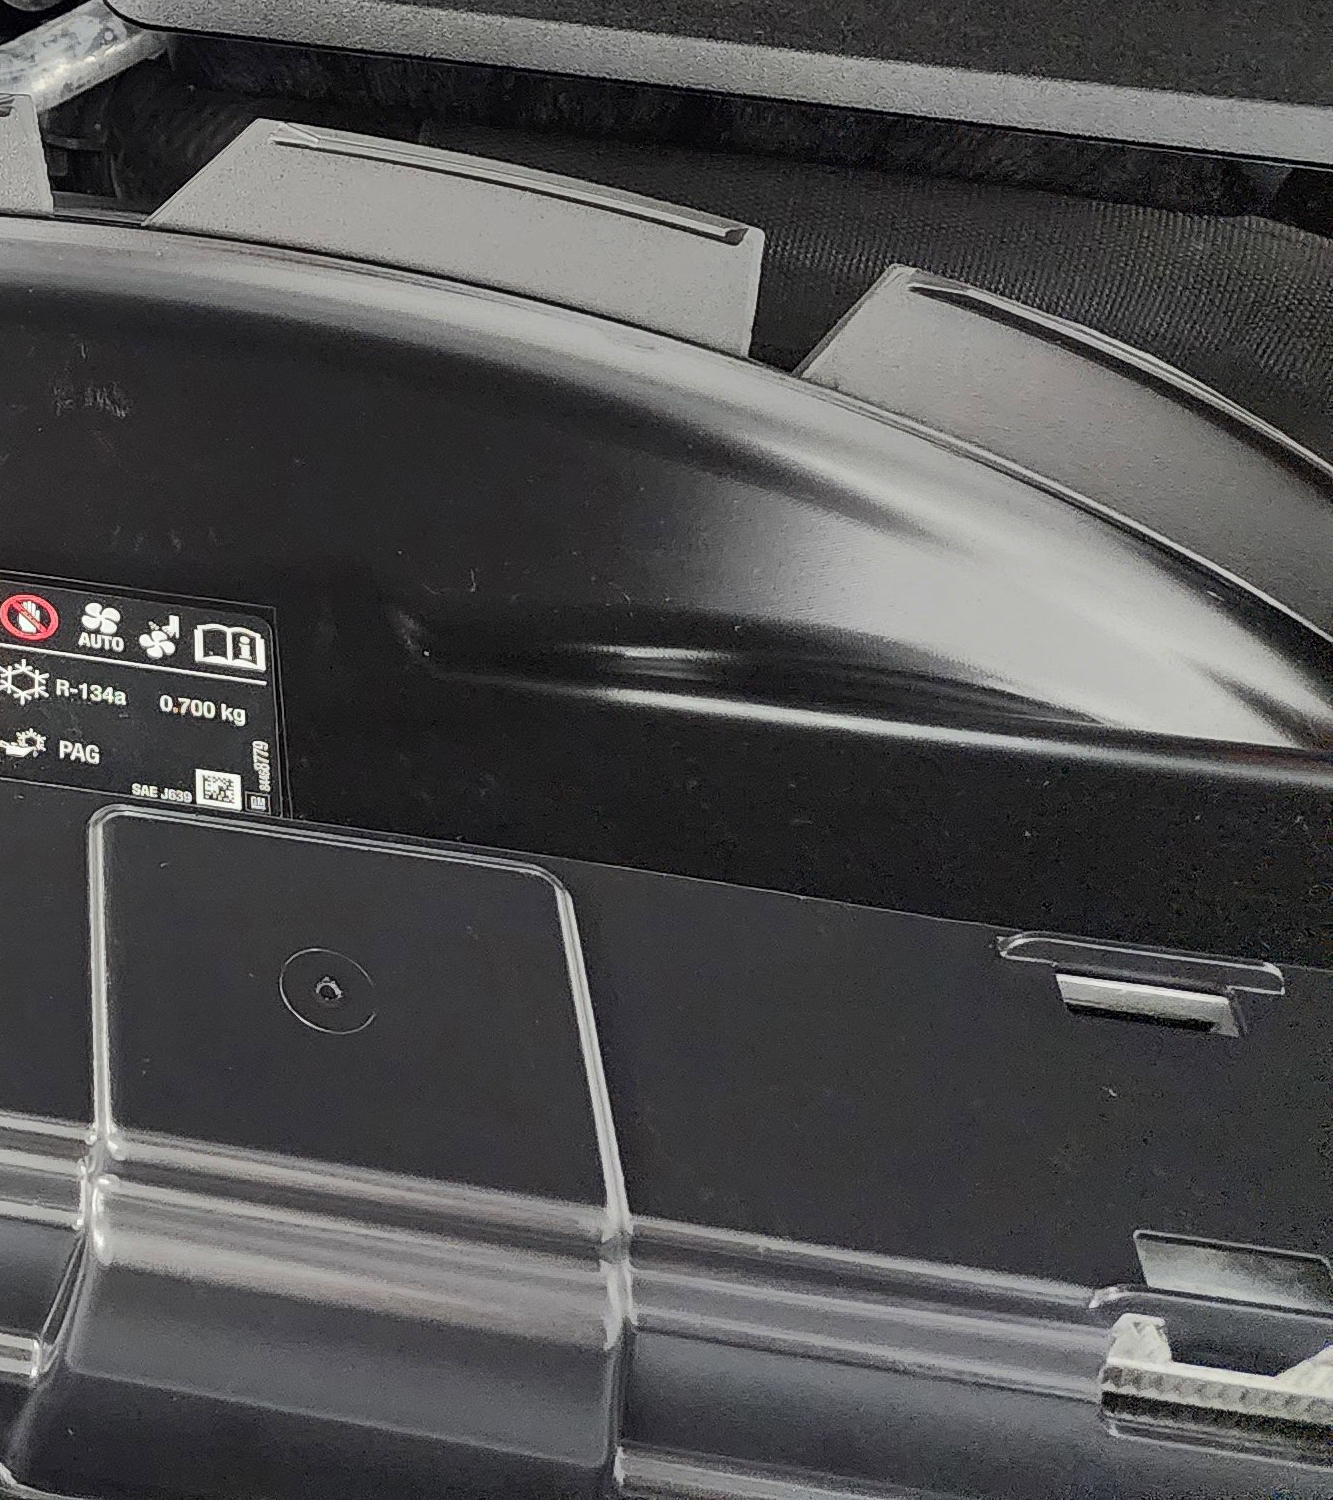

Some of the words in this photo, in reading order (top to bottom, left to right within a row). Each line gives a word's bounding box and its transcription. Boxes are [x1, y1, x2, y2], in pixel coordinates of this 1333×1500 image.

[78, 632, 125, 653] AUTO
[55, 679, 127, 707] R-134a
[159, 694, 216, 719] 0.700
[221, 703, 247, 727] kg
[58, 739, 101, 765] PAG
[131, 782, 159, 798] SAE
[160, 788, 193, 804] J639
